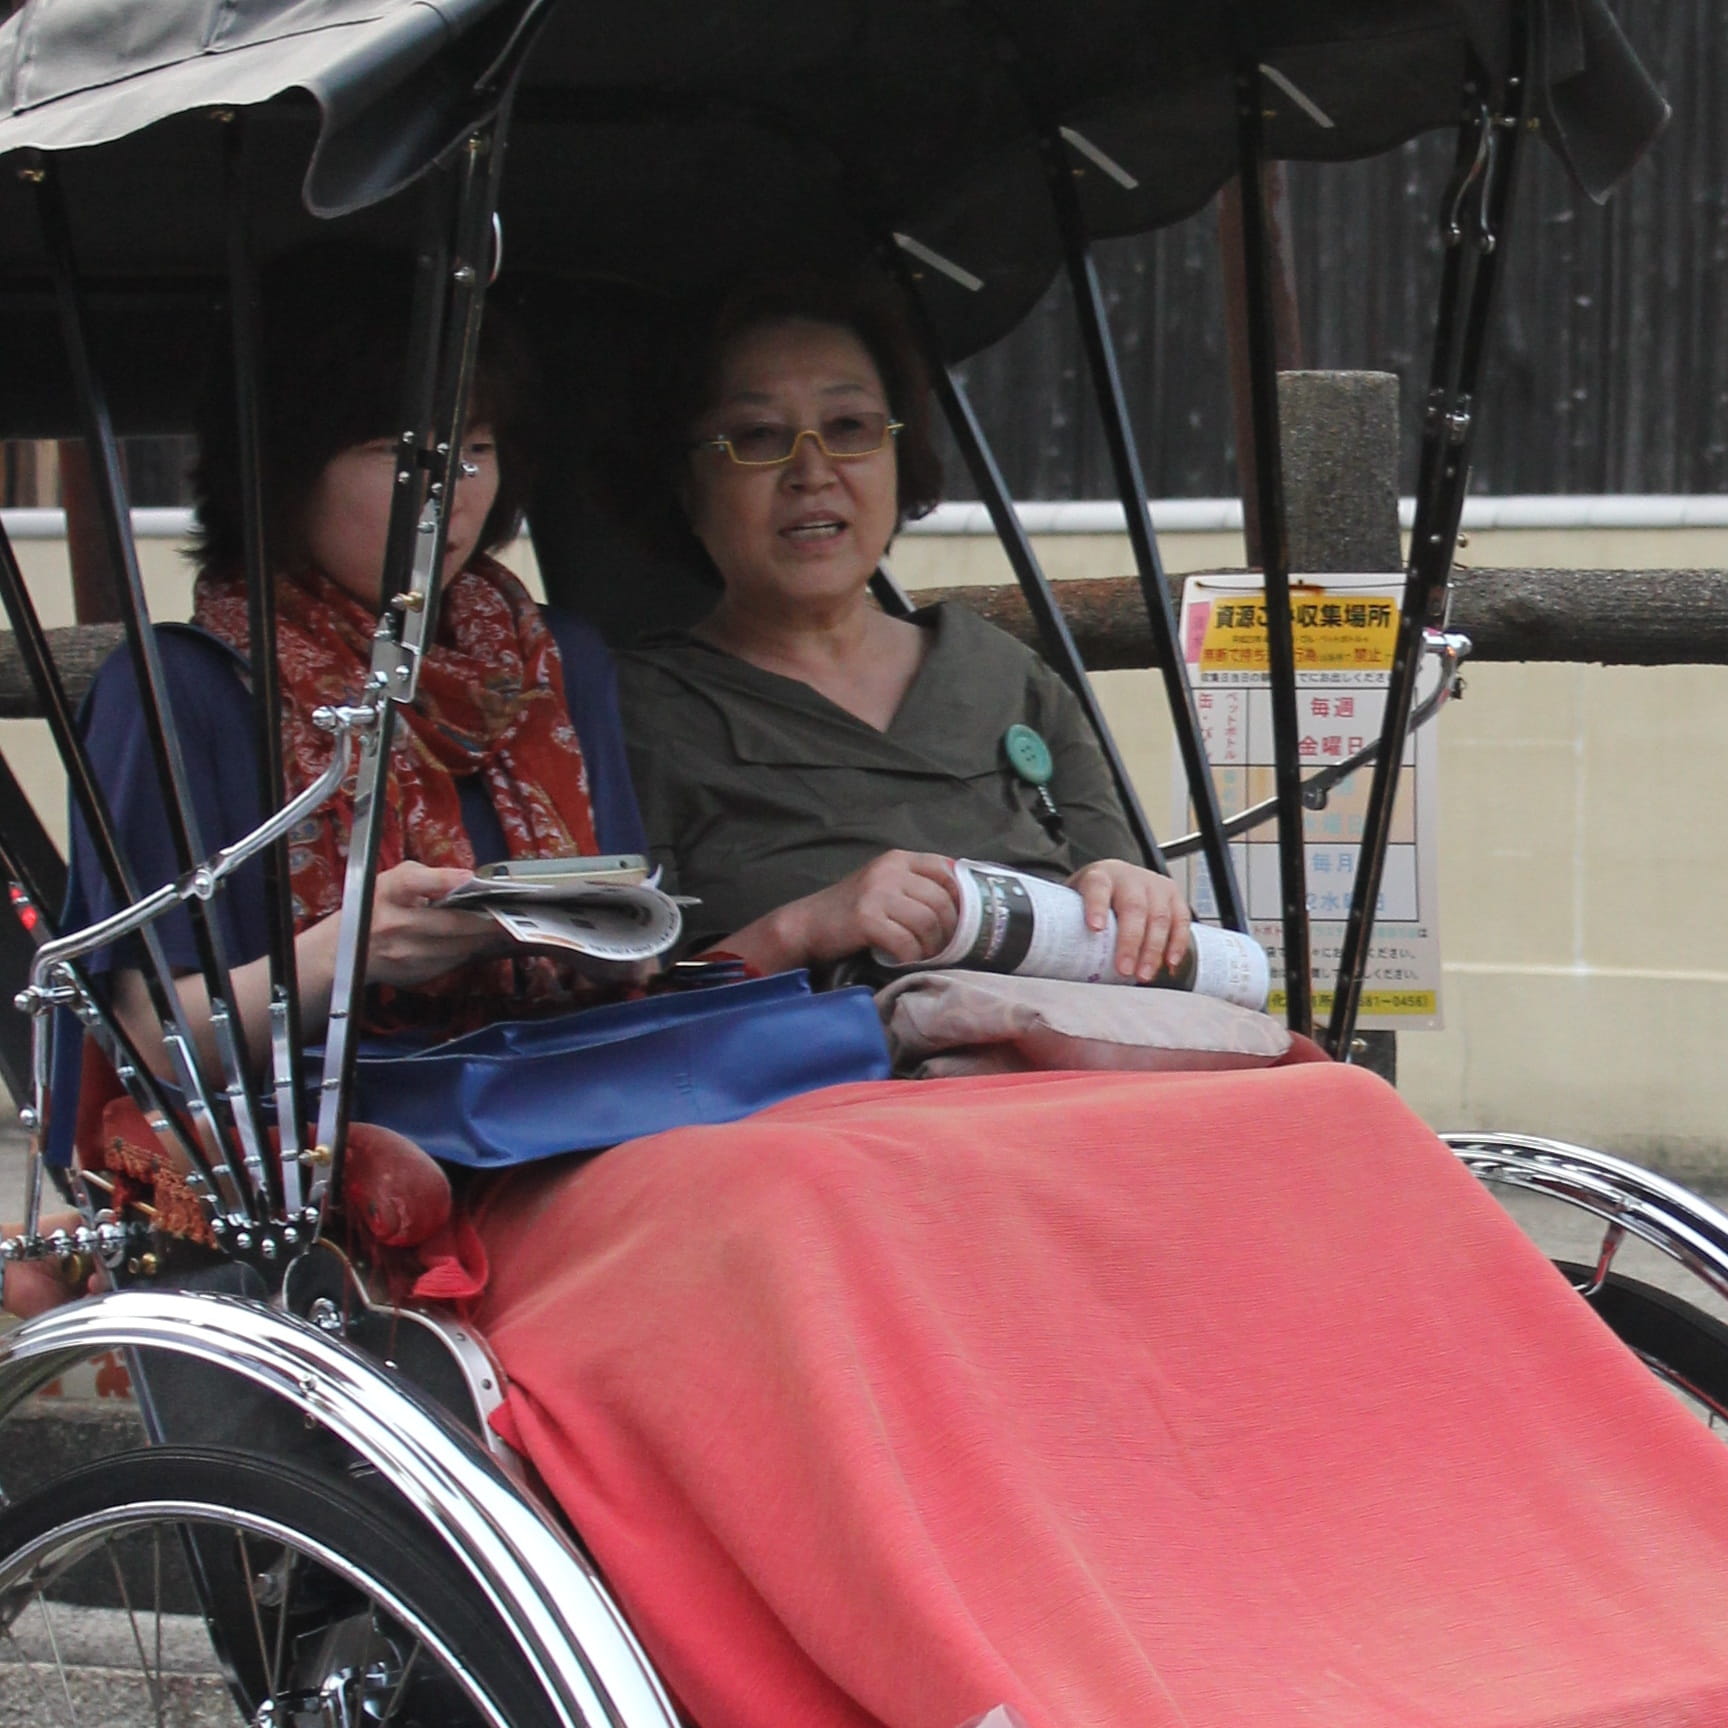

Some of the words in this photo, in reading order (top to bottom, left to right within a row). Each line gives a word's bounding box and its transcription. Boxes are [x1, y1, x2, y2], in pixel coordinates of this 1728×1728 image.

[1310, 697, 1355, 718] 毎週
[1298, 735, 1364, 756] 金曜日
